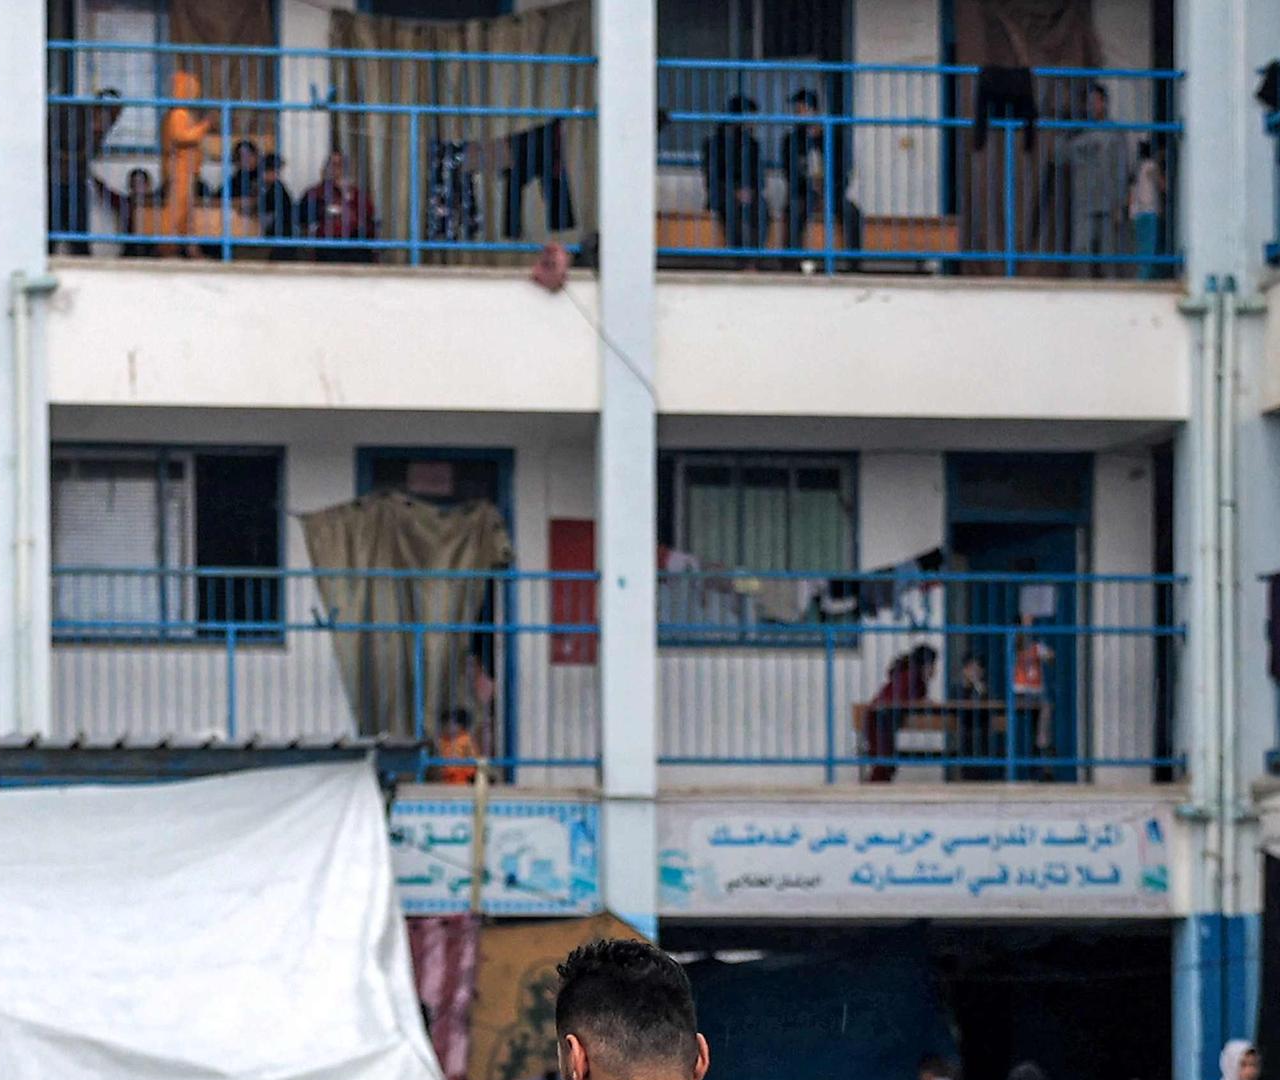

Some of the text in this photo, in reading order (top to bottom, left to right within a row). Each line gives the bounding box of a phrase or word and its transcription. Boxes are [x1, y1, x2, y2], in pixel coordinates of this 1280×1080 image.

[708, 823, 1123, 858] المرشد المدرسي حريص على خدمتك
[850, 861, 1122, 896] فلا تتردد في استشارته
